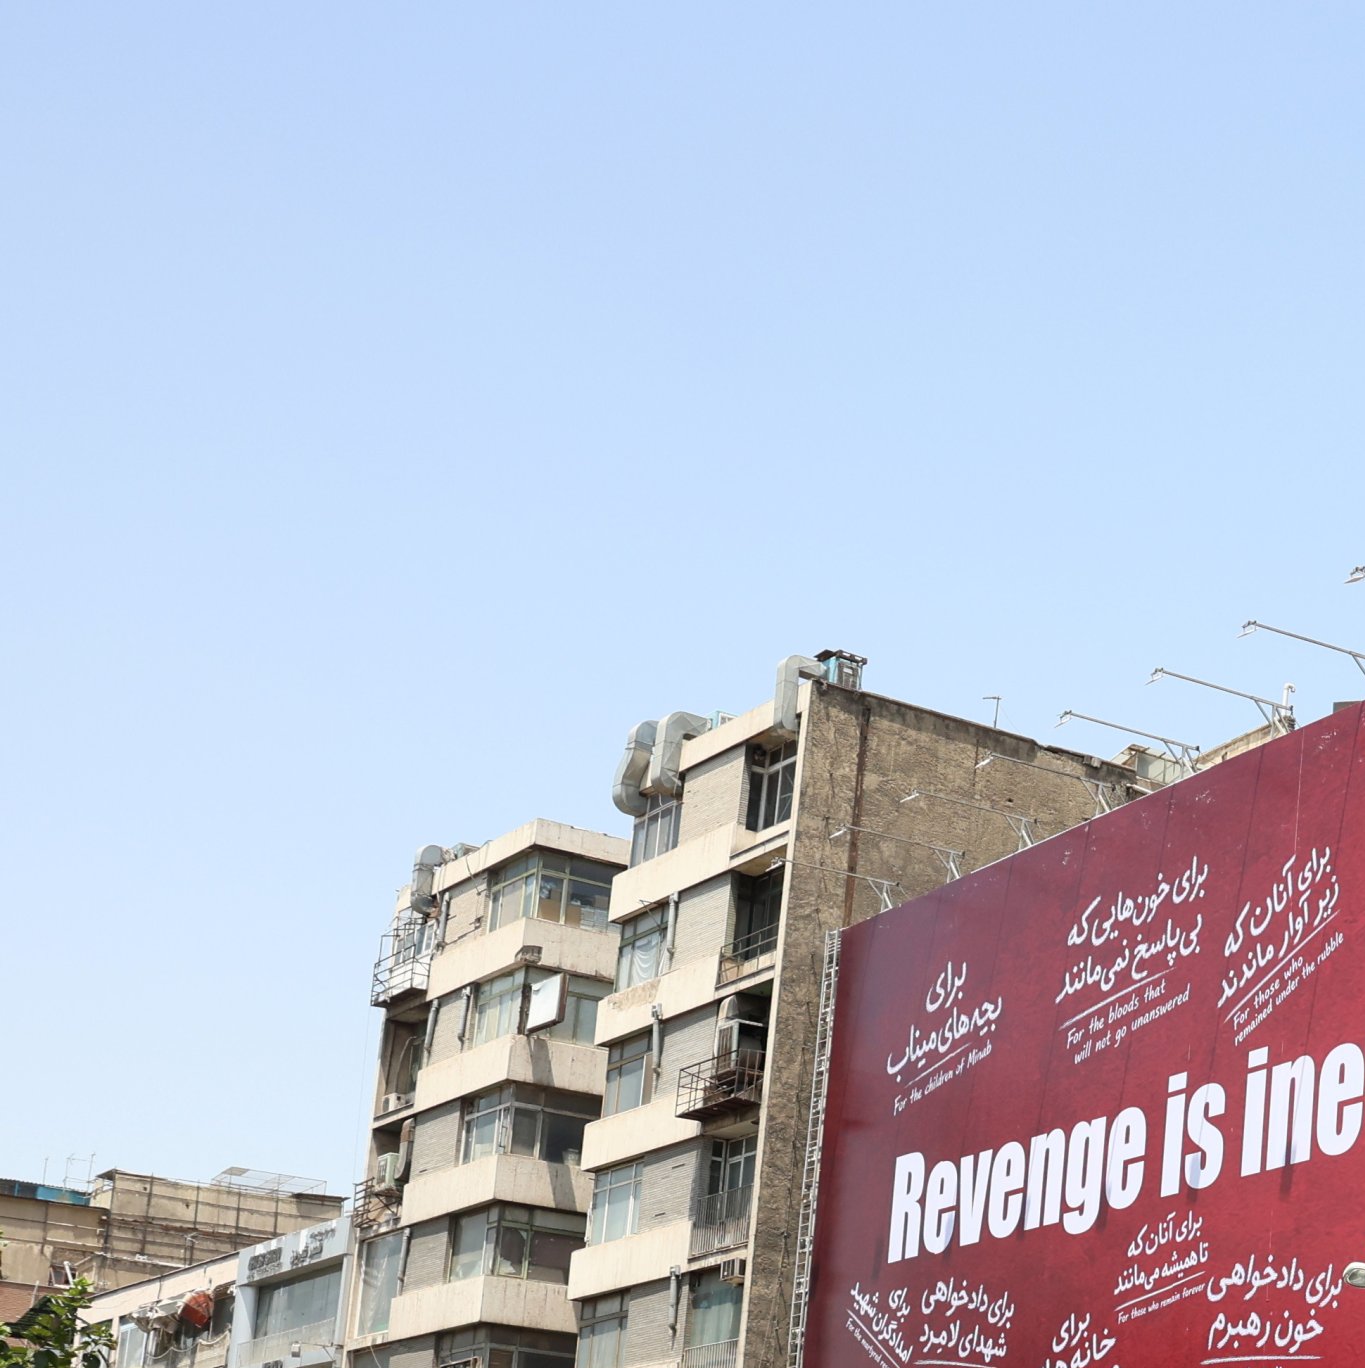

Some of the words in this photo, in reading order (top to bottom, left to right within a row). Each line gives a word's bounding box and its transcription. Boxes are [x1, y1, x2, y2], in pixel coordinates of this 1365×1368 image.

[926, 962, 967, 1012] برای
[1067, 1028, 1084, 1048] For
[1089, 1016, 1104, 1034] the
[1109, 994, 1135, 1023] bloods
[1137, 979, 1165, 1007] that
[1075, 1040, 1092, 1064] will
[1096, 1030, 1111, 1051] not
[1116, 1026, 1126, 1045] go
[1132, 985, 1190, 1030] unanswered
[894, 1095, 907, 1116] For
[910, 1088, 922, 1103] the
[925, 1070, 953, 1094] children
[957, 1058, 965, 1074] of
[968, 1041, 991, 1067] Minab
[887, 1106, 1147, 1261] Revenge
[1161, 1071, 1225, 1198] is
[921, 1277, 987, 1314] دادخواهی
[1208, 1254, 1304, 1301] دادخواهی
[1305, 1264, 1342, 1308] برای
[988, 1291, 1014, 1329] برای
[1052, 1312, 1090, 1353] برای
[1208, 1312, 1273, 1350] رهبرم
[1275, 1307, 1324, 1353] خون
